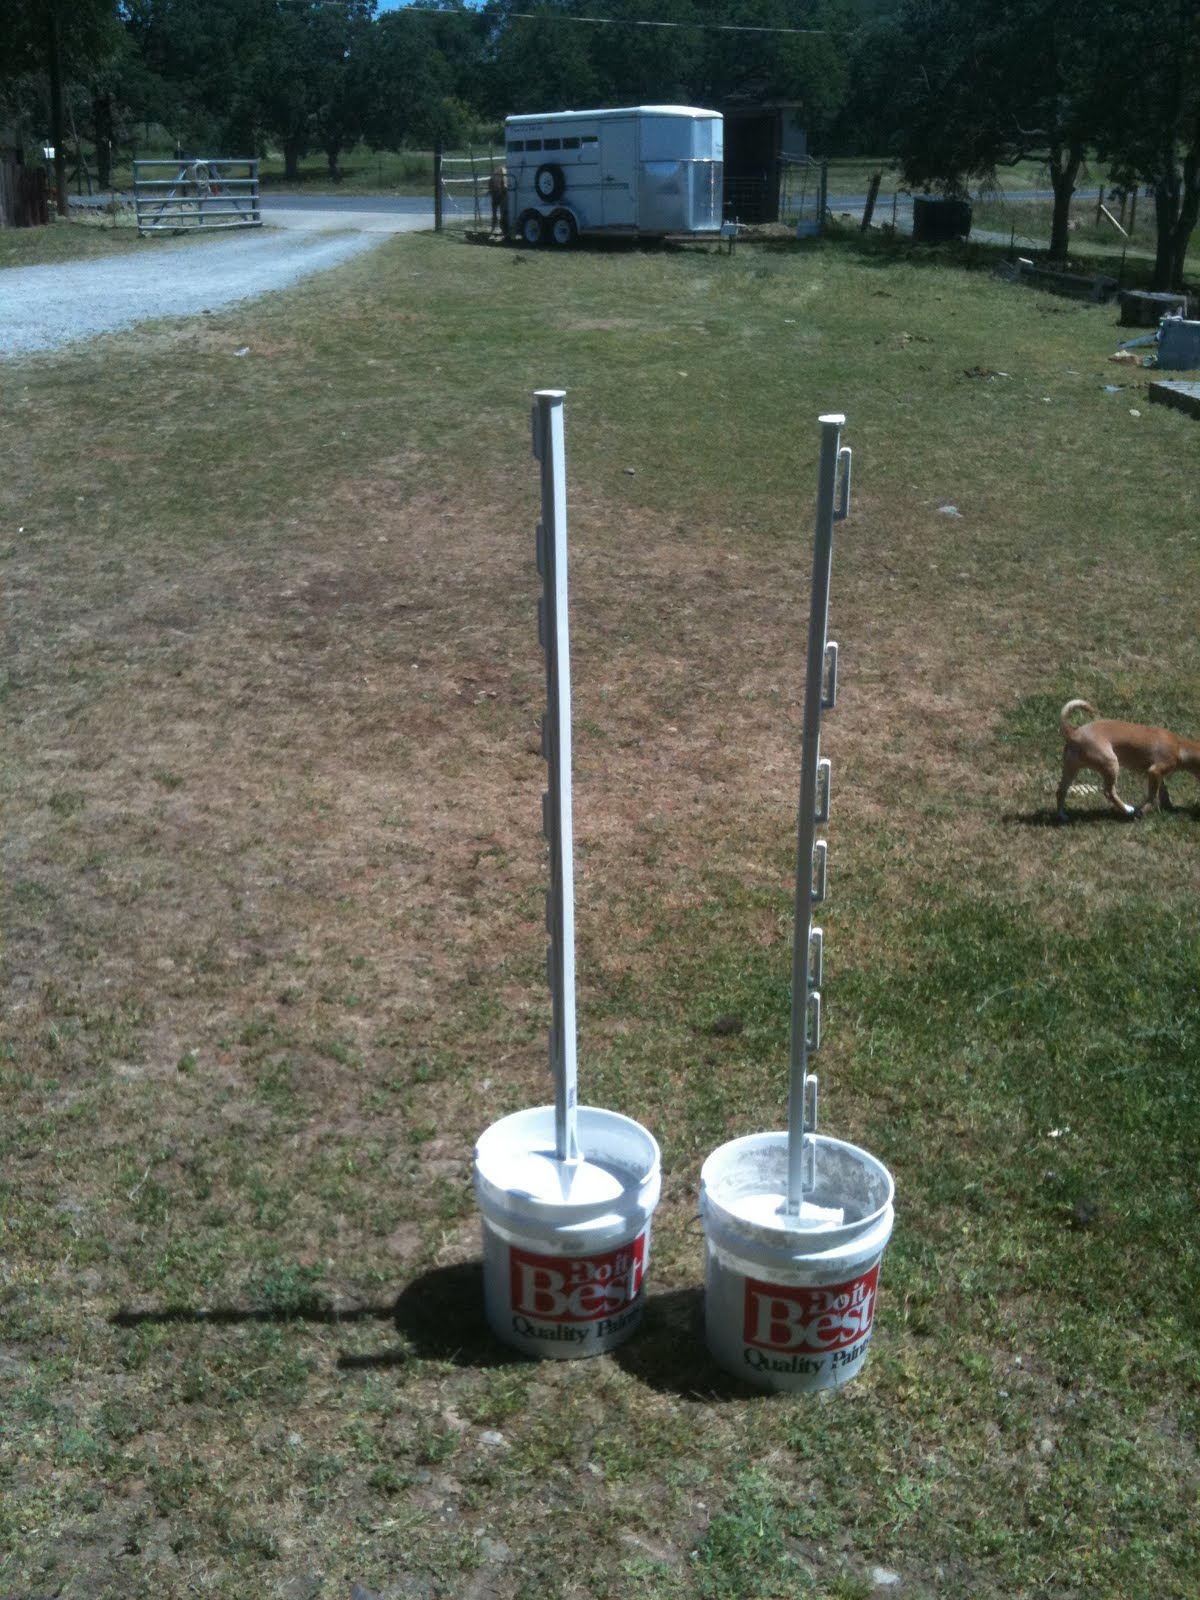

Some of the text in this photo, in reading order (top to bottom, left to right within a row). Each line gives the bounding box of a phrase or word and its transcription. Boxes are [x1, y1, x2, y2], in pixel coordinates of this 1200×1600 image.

[515, 1257, 641, 1316] Best
[570, 1261, 612, 1284] Do
[808, 1281, 867, 1314] Do it
[512, 1314, 590, 1344] Quality
[752, 1288, 875, 1347] Best
[744, 1347, 825, 1376] Quality
